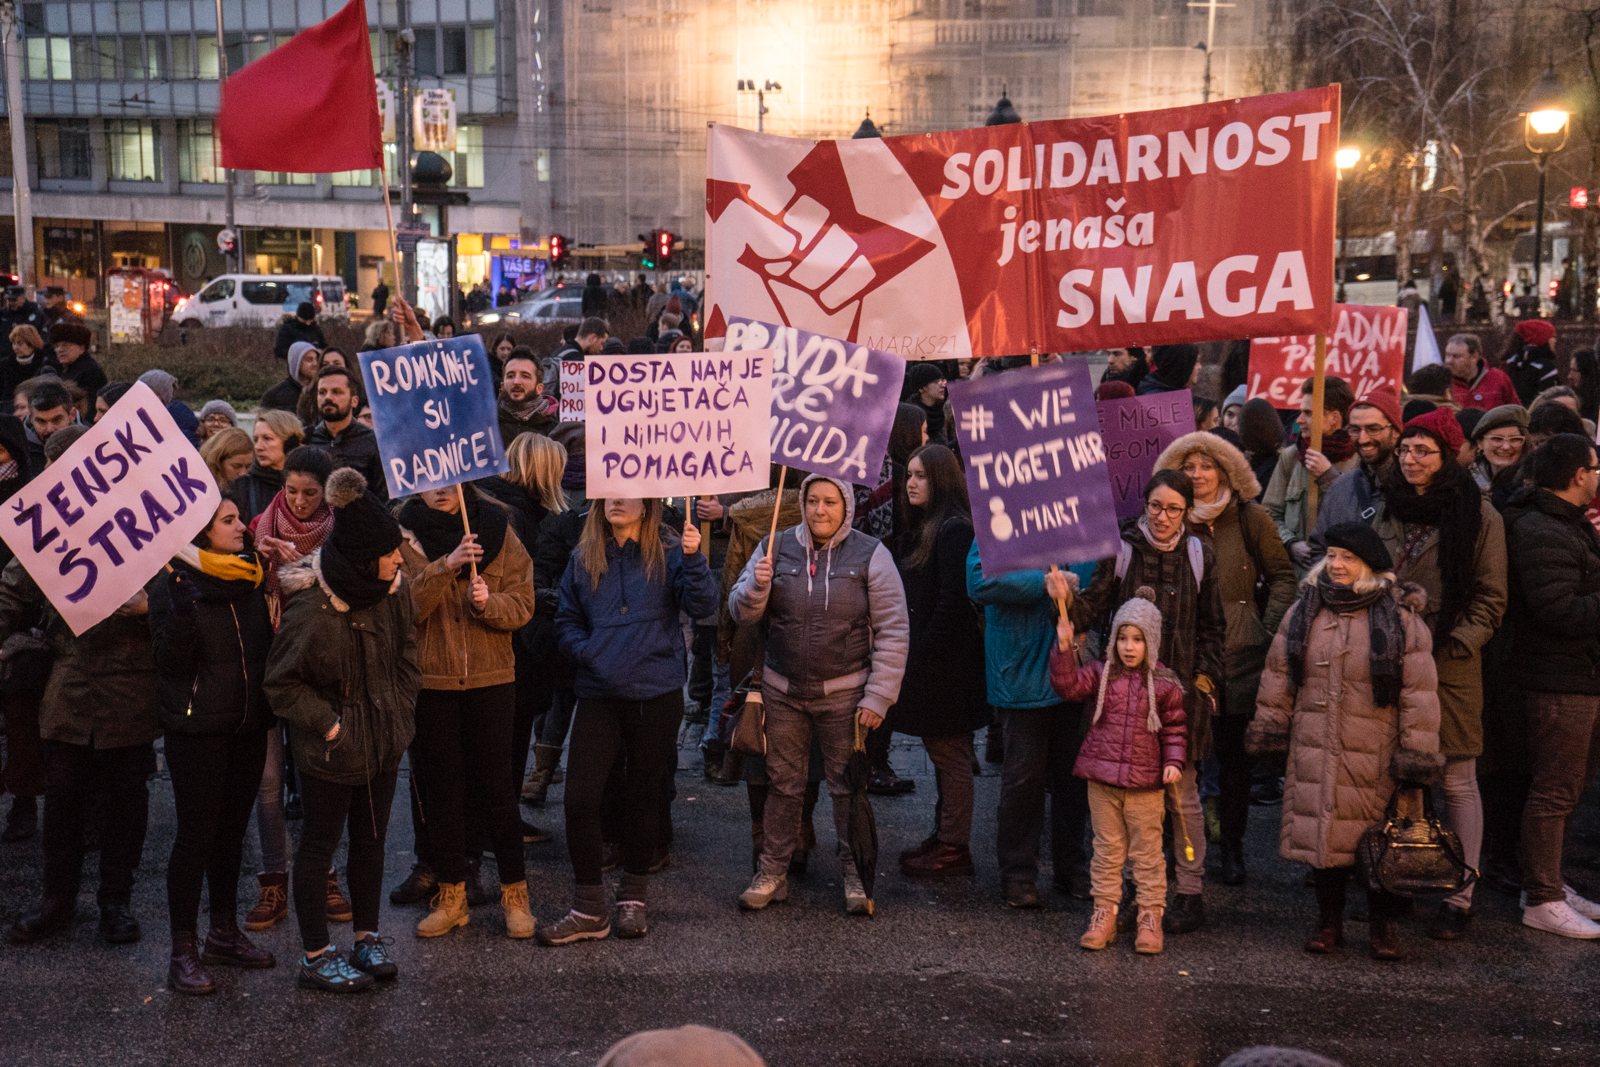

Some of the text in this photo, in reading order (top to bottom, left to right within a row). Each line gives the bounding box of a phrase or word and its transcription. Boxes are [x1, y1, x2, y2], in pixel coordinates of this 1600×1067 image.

[939, 111, 1332, 200] SOLIDARNOST
[1056, 250, 1314, 329] SNAGA
[866, 335, 957, 355] MARKS21
[588, 357, 764, 385] DOSTA NAM JE
[423, 398, 451, 430] SU
[601, 425, 607, 445] I
[11, 407, 164, 553] ŽENSKI
[602, 442, 754, 480] POMAGAČA
[970, 431, 1107, 490] TOGETHER
[54, 456, 207, 604] ŠTRAJK
[1021, 496, 1080, 535] MART
